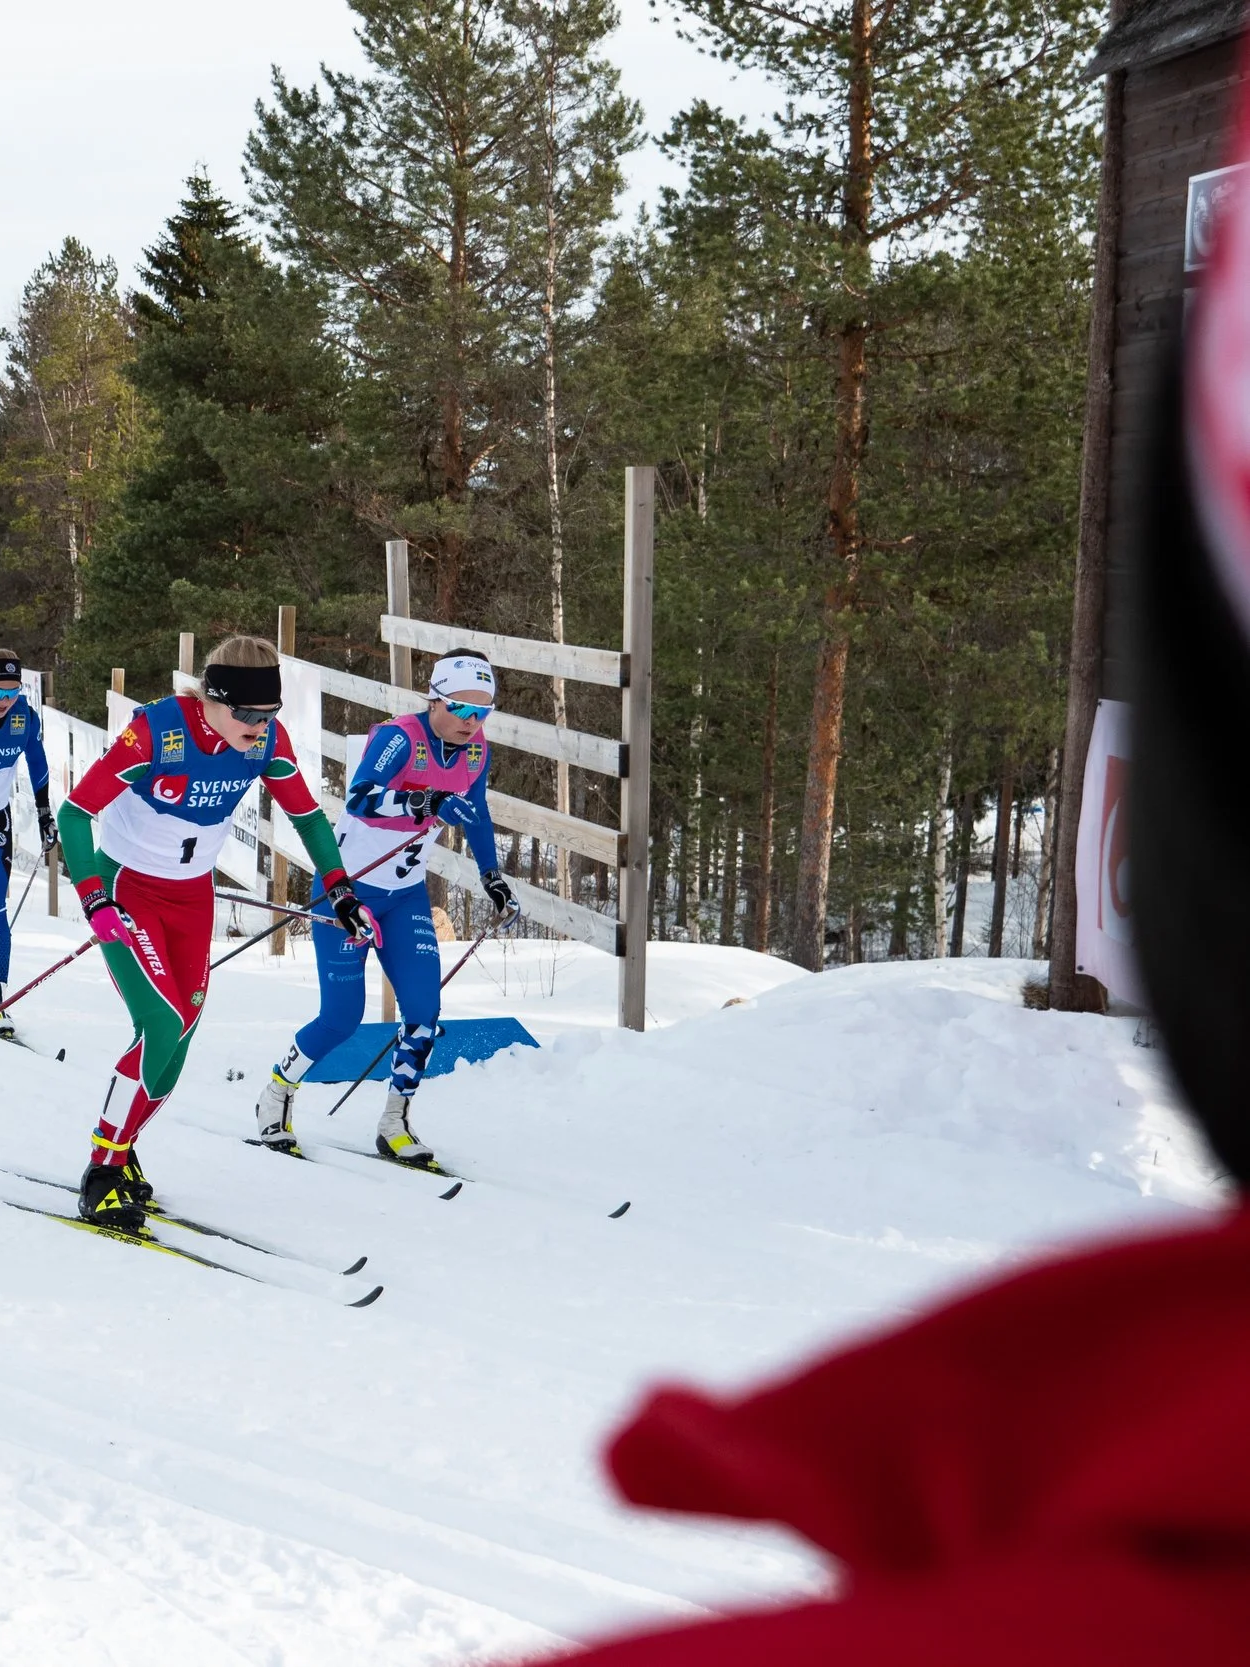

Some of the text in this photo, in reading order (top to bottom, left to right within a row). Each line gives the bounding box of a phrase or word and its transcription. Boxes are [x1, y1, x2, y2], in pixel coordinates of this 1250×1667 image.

[374, 734, 404, 773] IGGESUND
[187, 795, 223, 808] SPEL
[180, 836, 197, 864] 1
[395, 843, 423, 879] 3
[136, 928, 166, 976] TRIMTEX
[280, 1044, 299, 1072] 3
[97, 1228, 142, 1246] FISCHER
